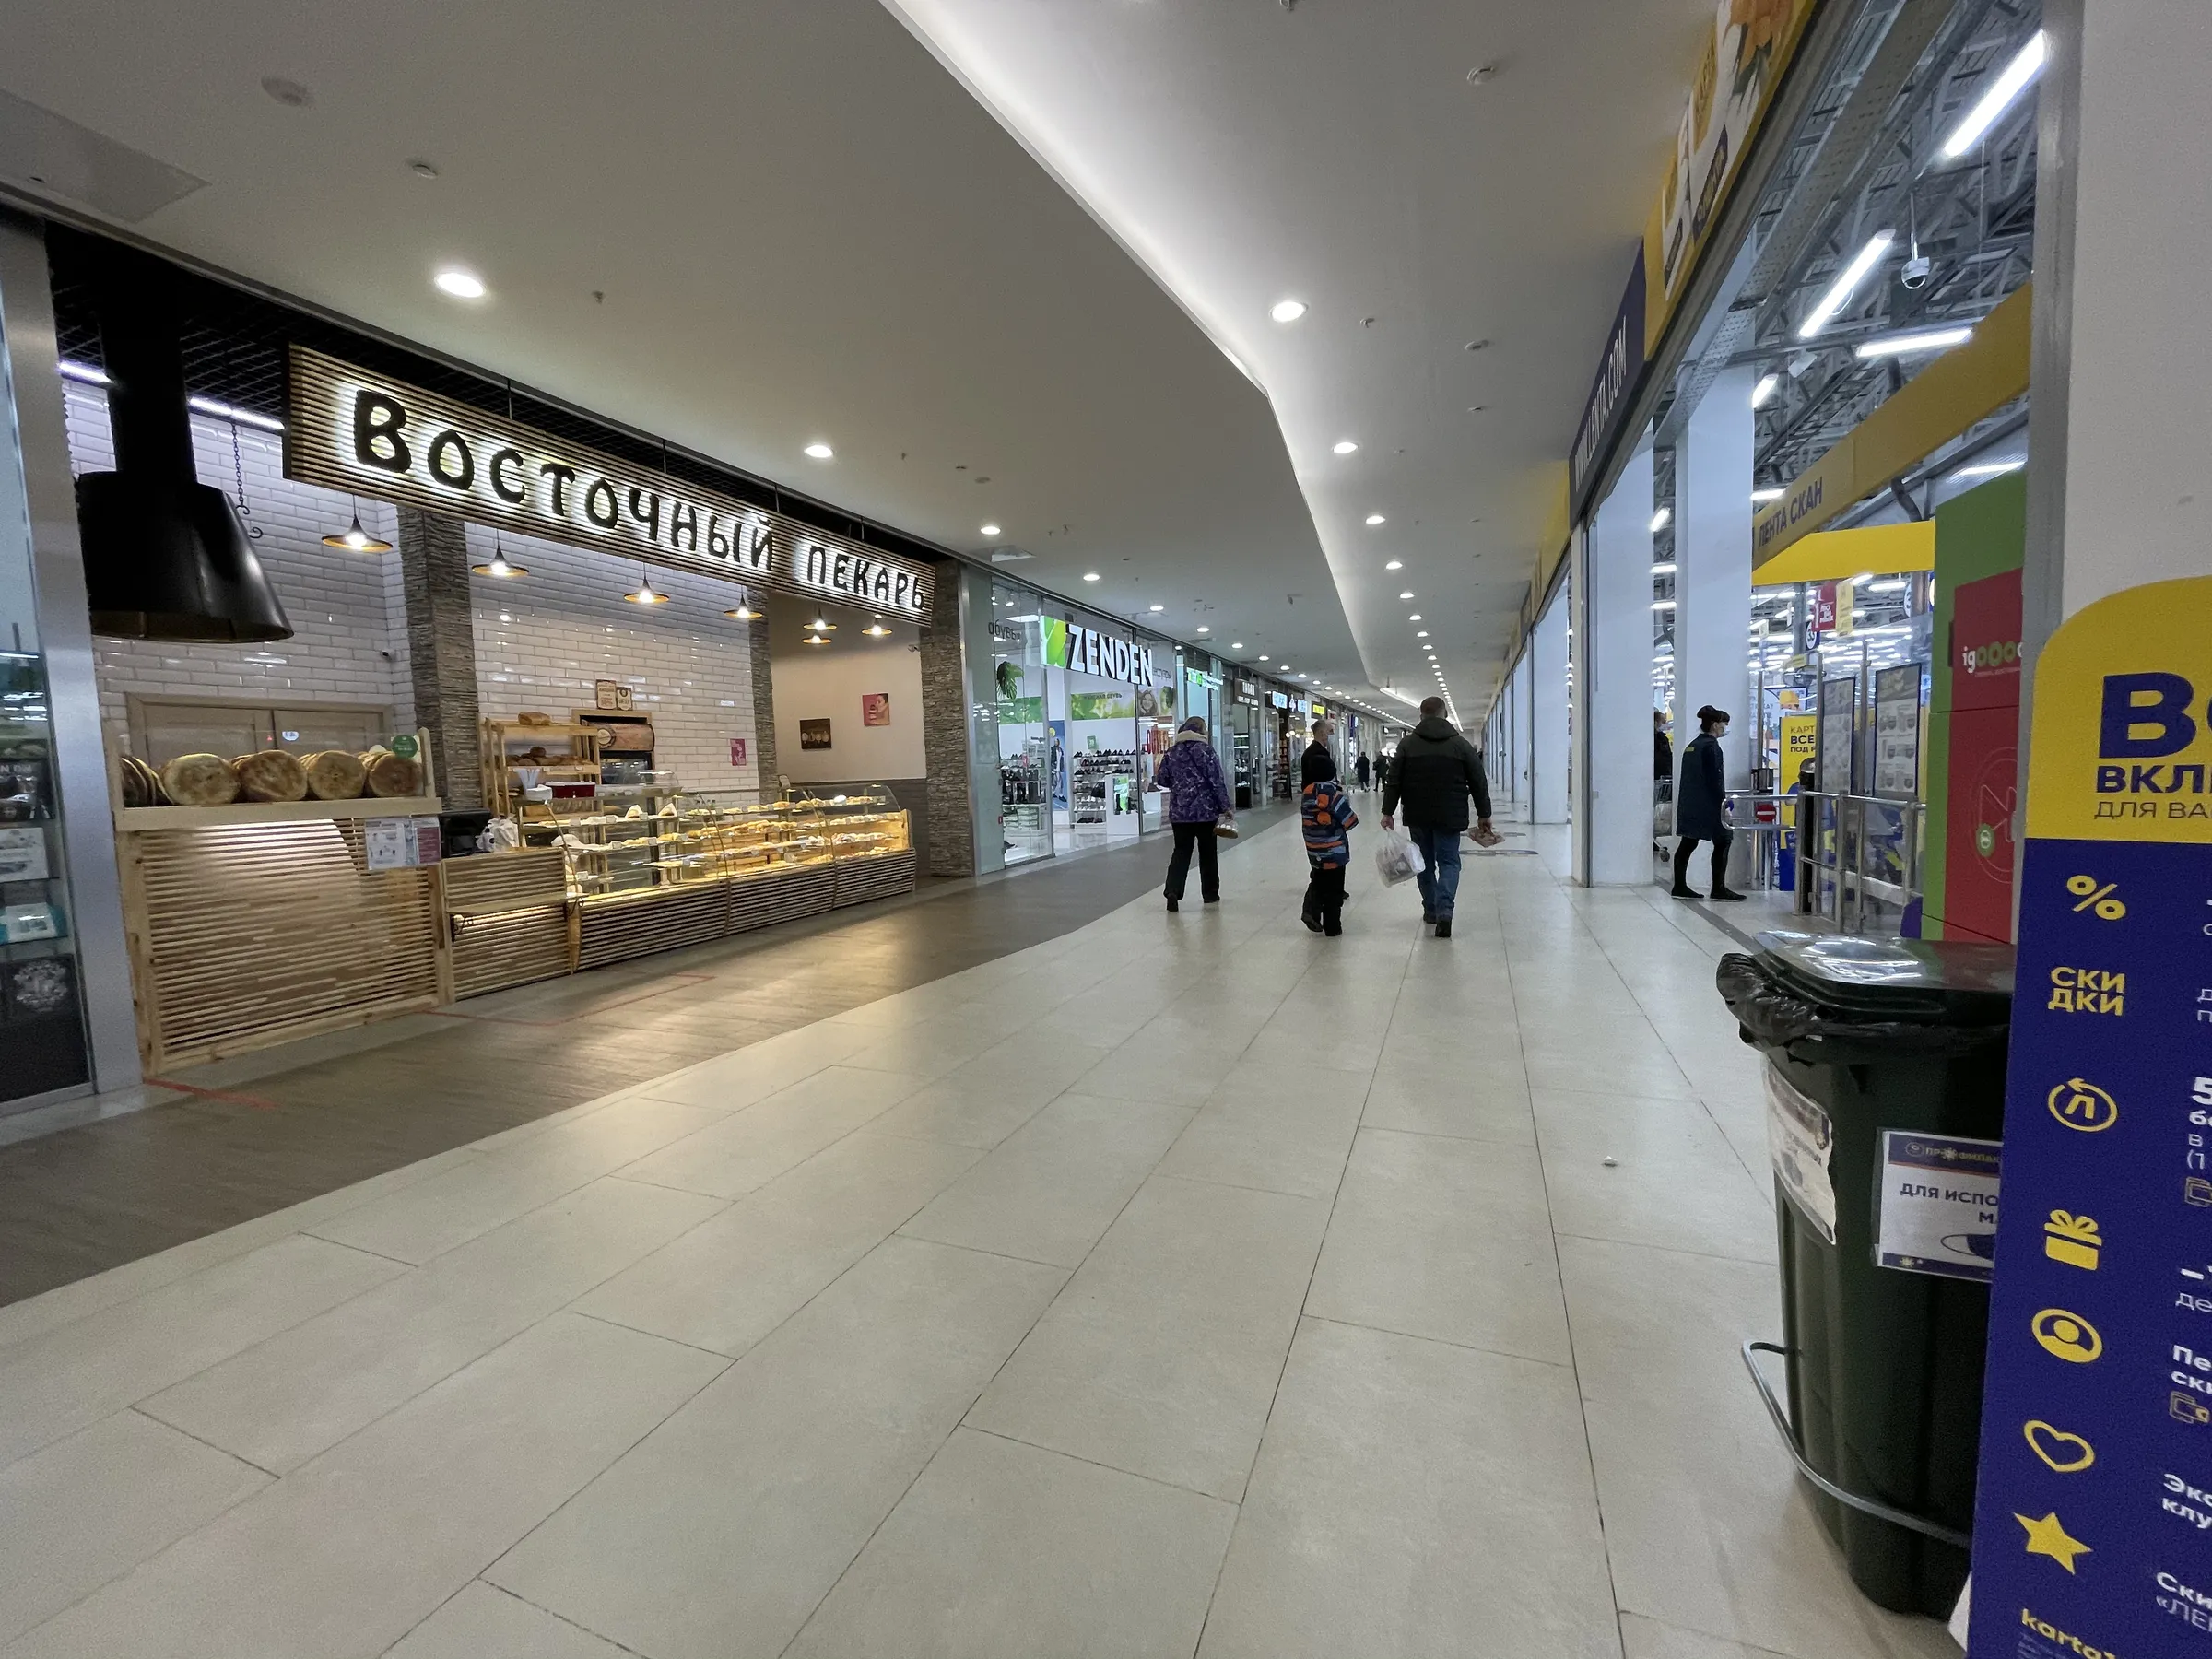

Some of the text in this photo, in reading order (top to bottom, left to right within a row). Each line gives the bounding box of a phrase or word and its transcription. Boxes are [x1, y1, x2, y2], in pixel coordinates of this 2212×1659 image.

[1758, 476, 1823, 548] ЛЕНТА СКАН
[1067, 624, 1154, 687] ZENDEN
[2099, 672, 2212, 759] В
[2096, 764, 2212, 794] ВКЛ
[2094, 801, 2212, 820] ДЛЯ ВА
[2051, 967, 2125, 994] СКИ
[2048, 987, 2124, 1017] ДКИ
[1900, 1183, 1939, 1198] ДЛЯ
[2021, 1608, 2117, 1659] karta
